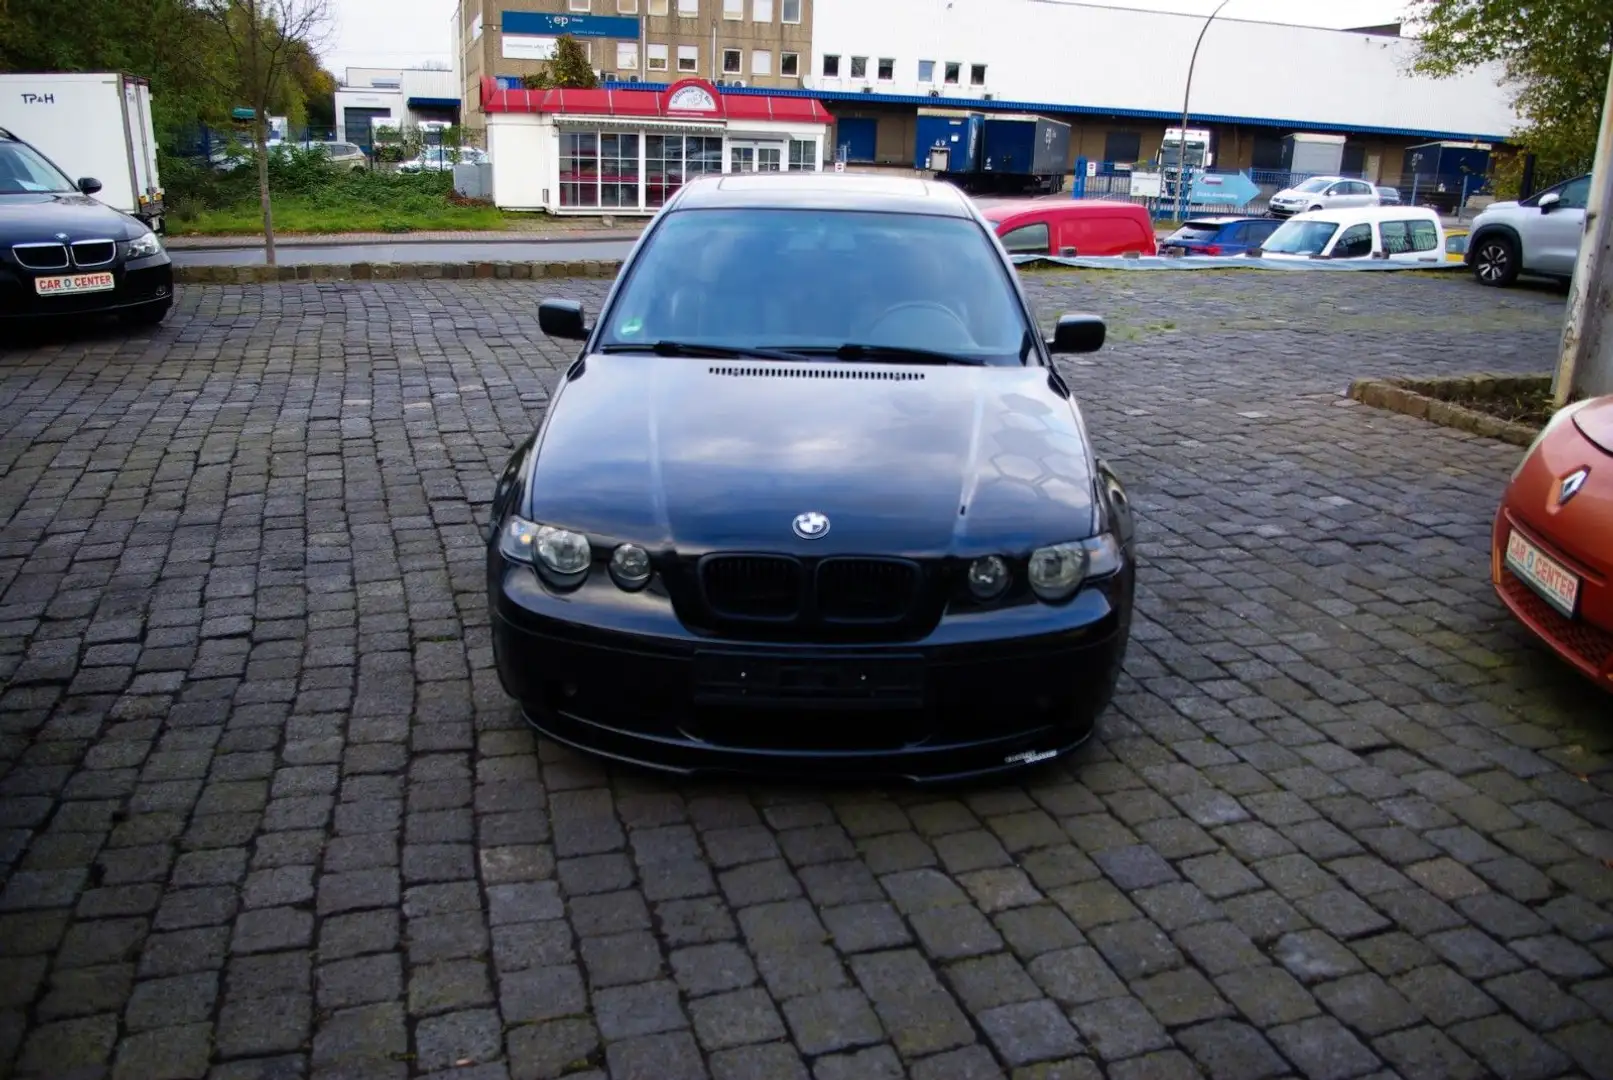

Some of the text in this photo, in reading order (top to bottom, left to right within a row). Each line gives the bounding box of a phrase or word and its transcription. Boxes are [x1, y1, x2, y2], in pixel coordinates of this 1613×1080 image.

[553, 16, 569, 27] ep
[39, 280, 61, 290] CAR
[74, 275, 112, 287] CENTER
[1509, 535, 1526, 563] CAR
[1535, 557, 1575, 600] CENTER
